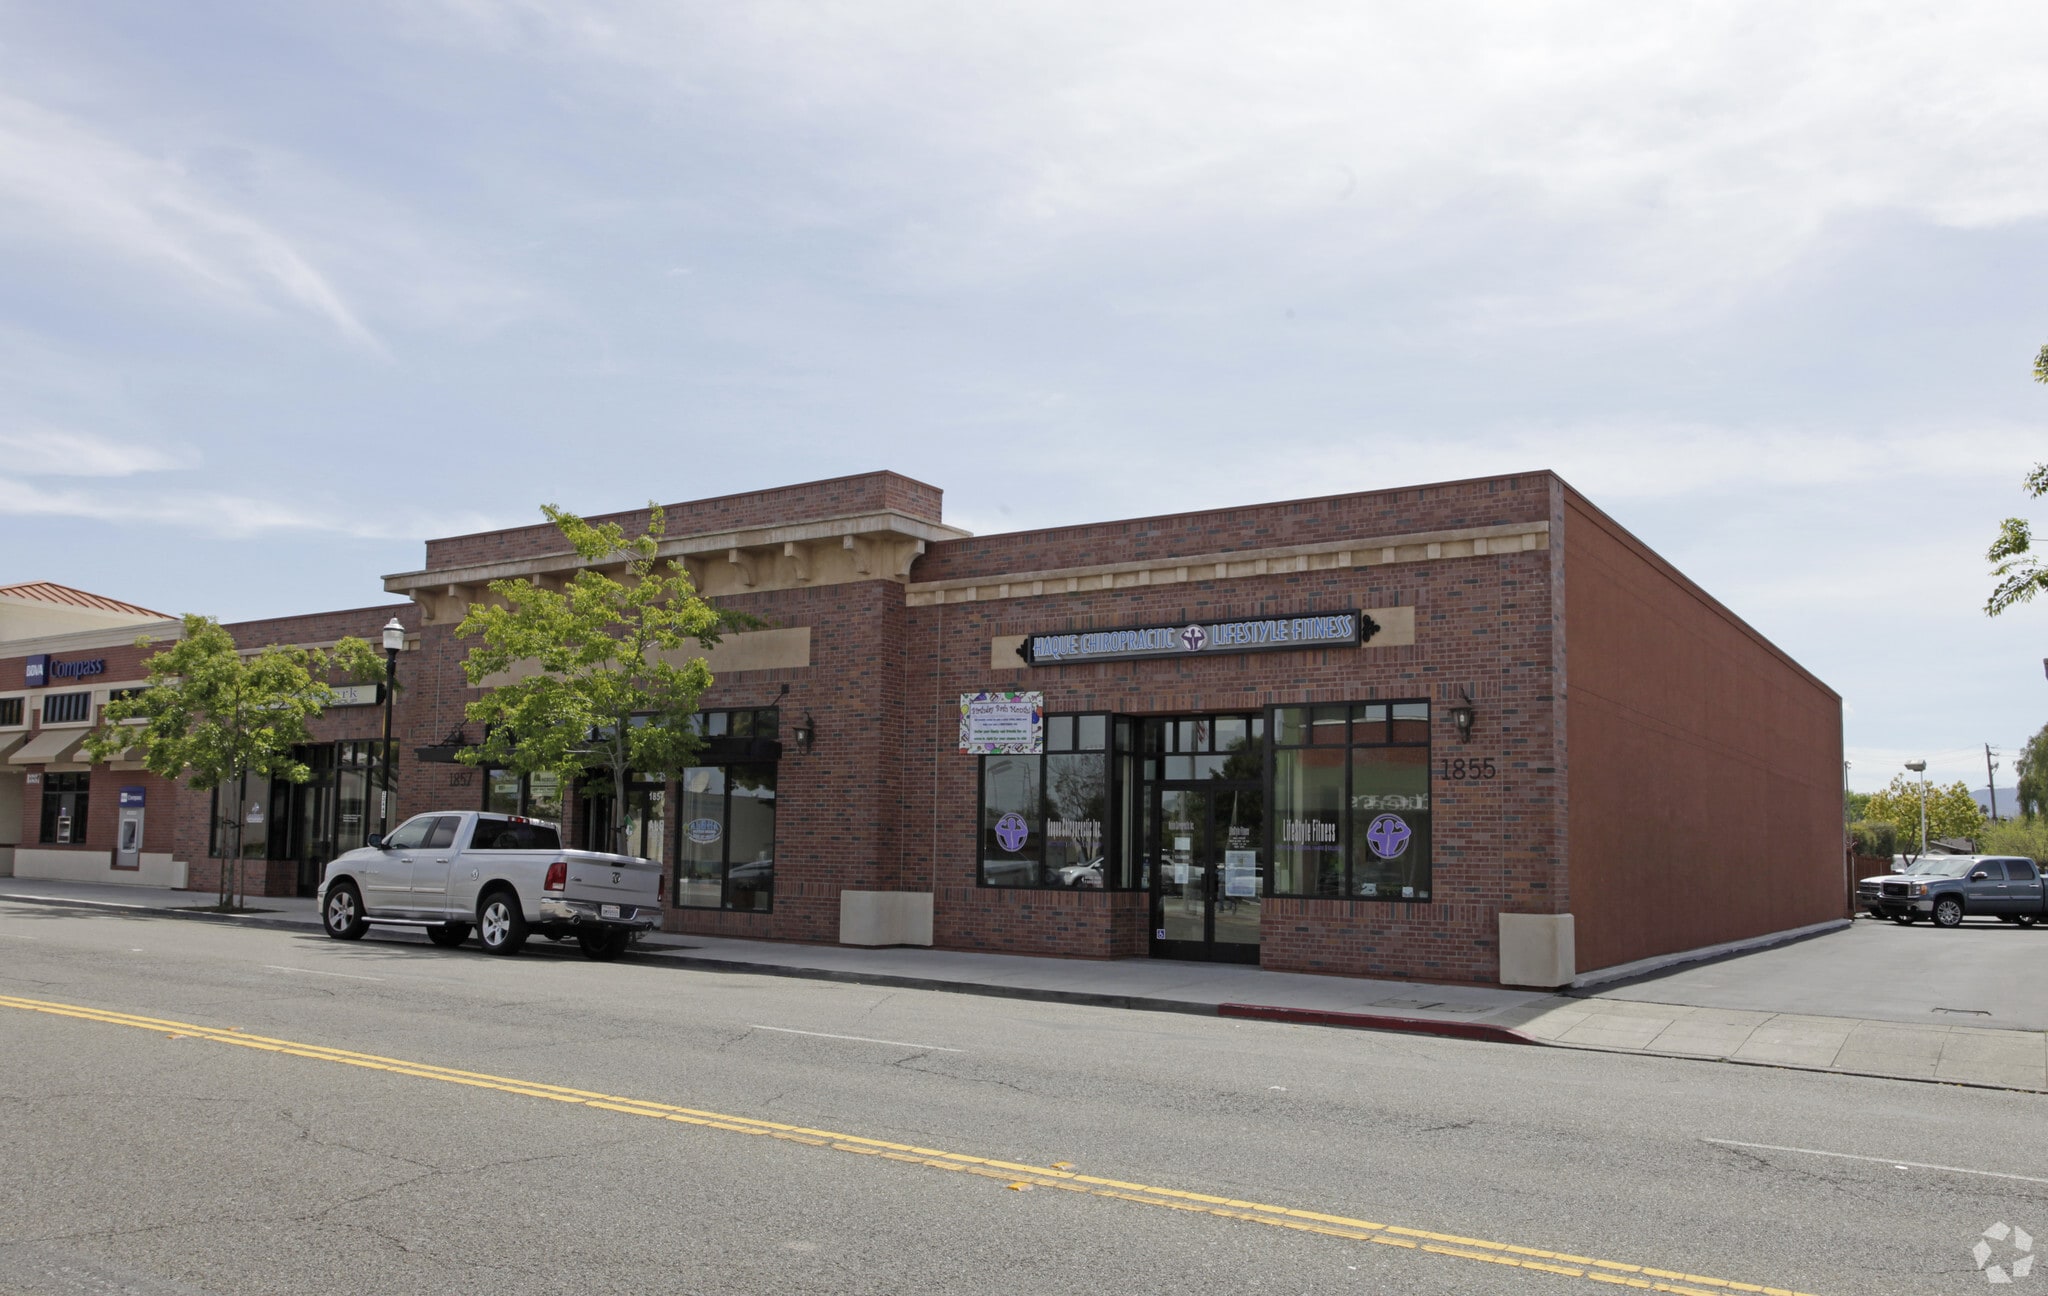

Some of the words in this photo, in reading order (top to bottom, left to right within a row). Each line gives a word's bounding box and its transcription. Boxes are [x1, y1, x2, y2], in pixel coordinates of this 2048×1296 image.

[1033, 635, 1078, 661] HAQUE
[1080, 627, 1175, 655] CHIROPRACTIC
[1212, 620, 1288, 646] LIFESTYLE
[1291, 614, 1353, 641] FITNESS
[26, 664, 44, 677] BBVA
[49, 657, 104, 681] Compass
[449, 772, 473, 787] 1857
[1441, 757, 1496, 780] 1855
[1312, 819, 1336, 842] Fitness
